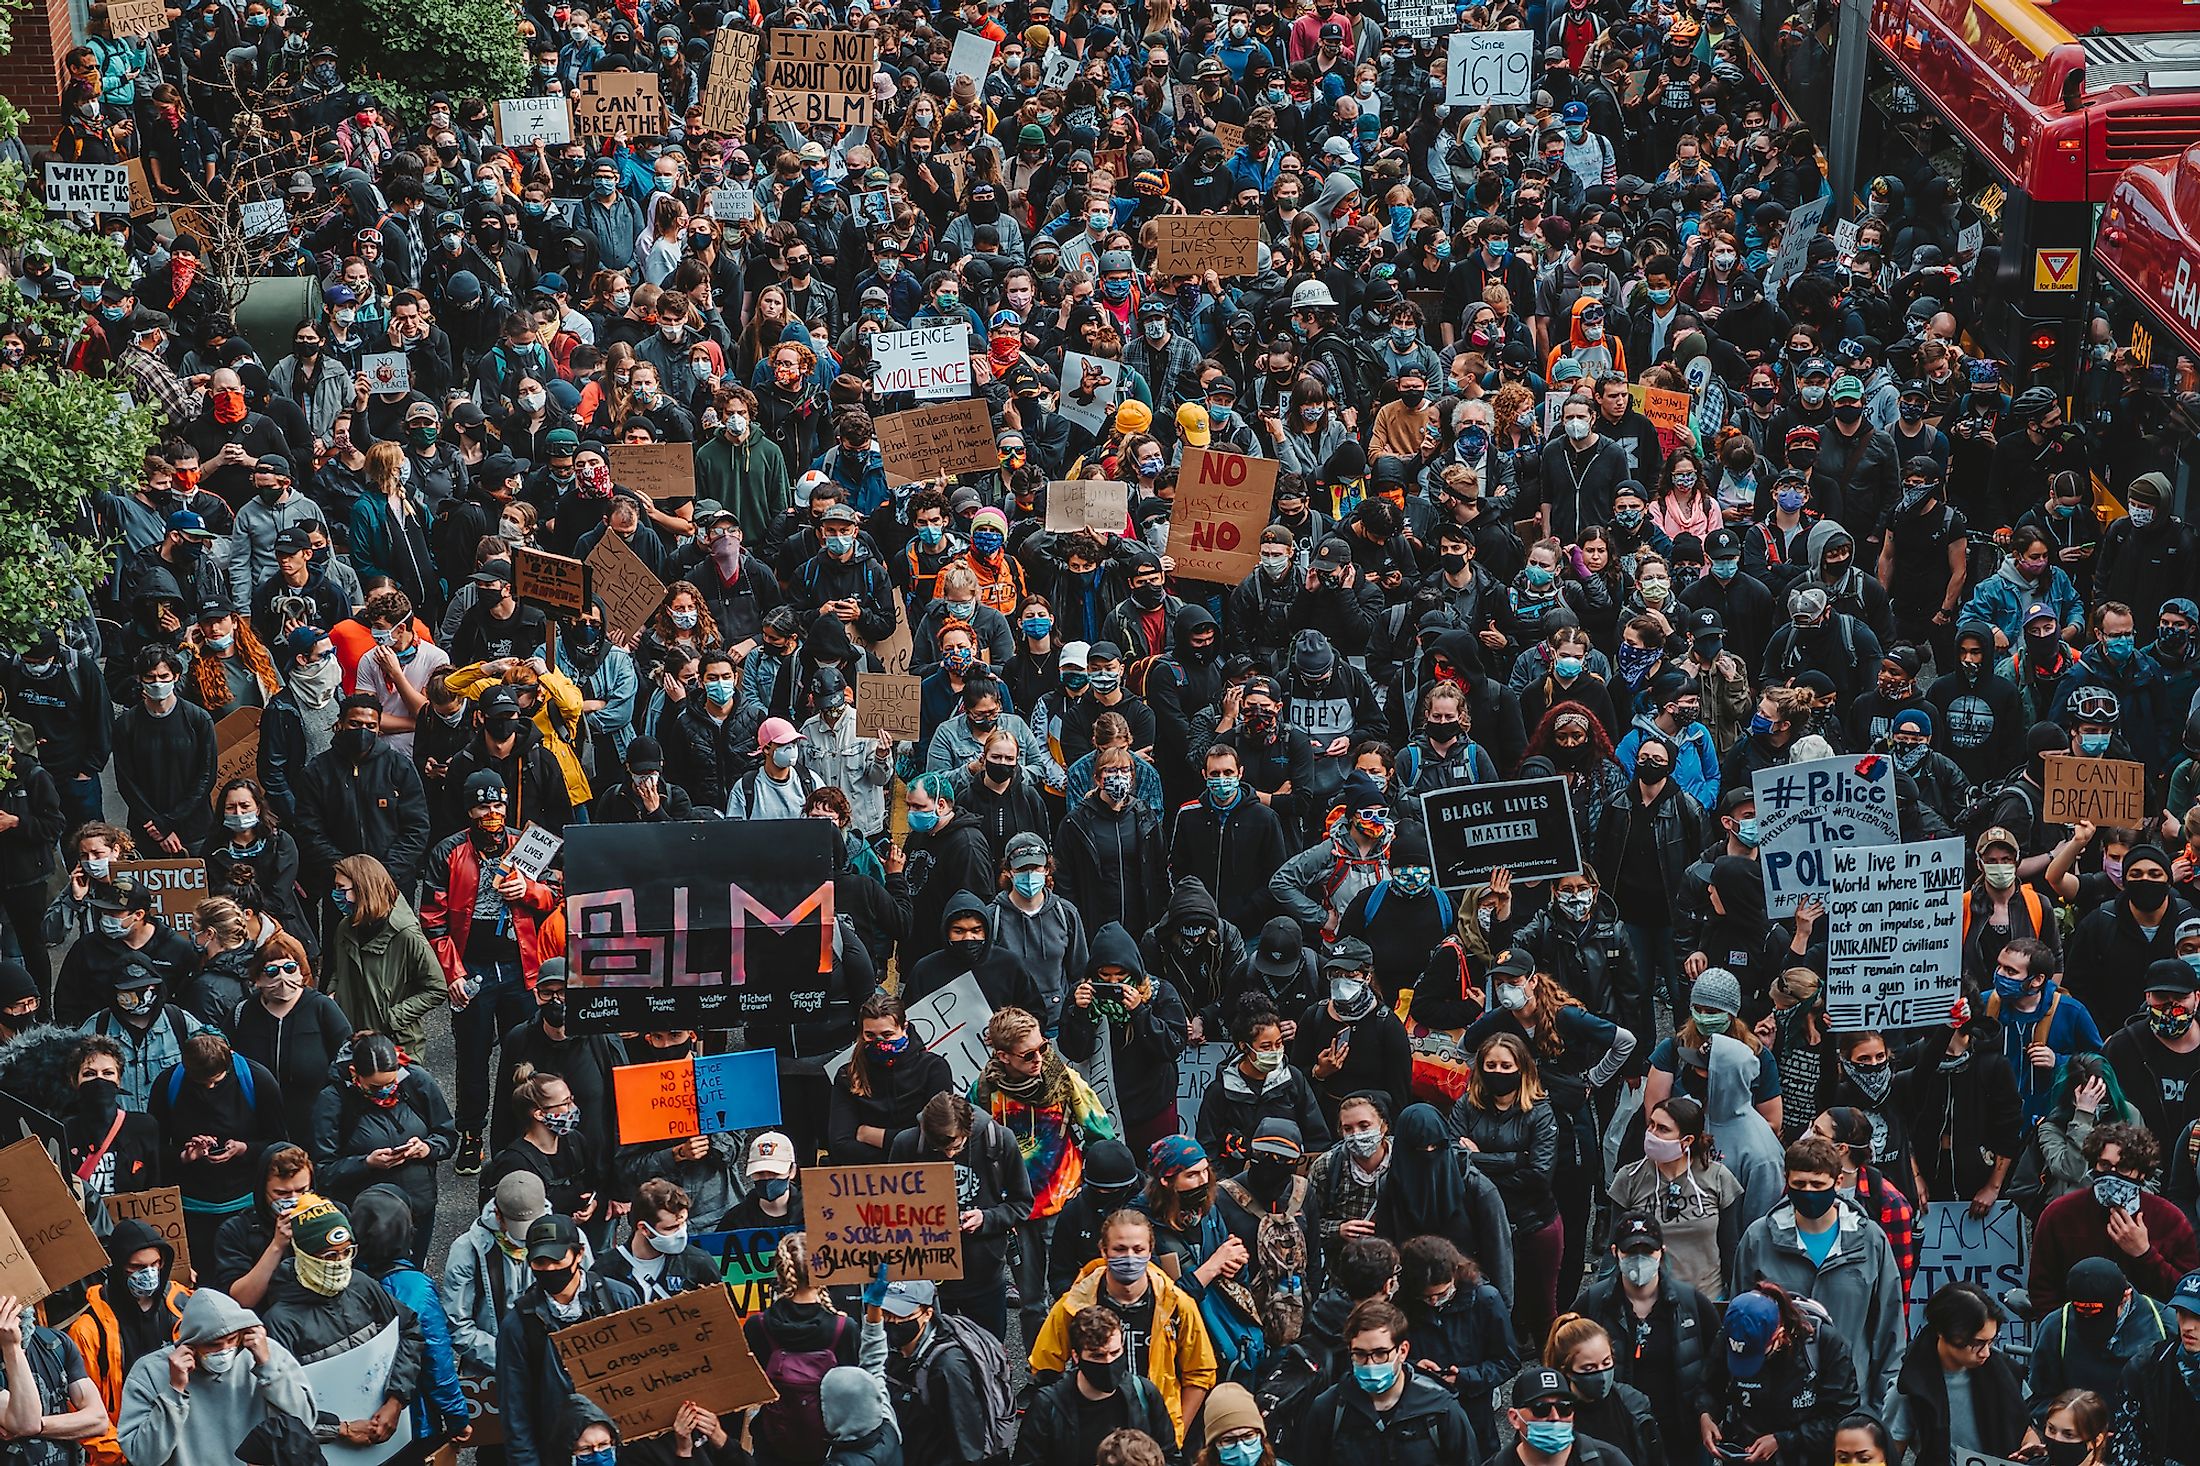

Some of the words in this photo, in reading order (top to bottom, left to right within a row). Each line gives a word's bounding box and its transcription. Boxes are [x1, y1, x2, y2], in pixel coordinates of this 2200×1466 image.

[114, 1, 159, 20] LIVES
[1389, 6, 1427, 18] oppressed
[1447, 5, 1455, 13] to
[111, 13, 167, 34] MATTER
[1401, 18, 1422, 28] react
[1426, 17, 1434, 25] to
[1438, 15, 1455, 24] their
[714, 29, 758, 62] BLACK
[832, 34, 872, 61] NOT
[1470, 36, 1505, 51] Since
[1985, 34, 2009, 62] HYBRID
[711, 53, 754, 83] LIVES
[771, 61, 830, 90] ABOUT
[833, 63, 871, 93] YOU
[1455, 53, 1530, 97] 1619
[583, 75, 598, 95] I
[719, 78, 736, 88] ARE
[1050, 78, 1065, 87] BLM
[508, 99, 560, 111] MIGHT
[596, 88, 654, 113] CAN'T
[705, 84, 749, 113] HUMAN
[583, 114, 659, 134] BREATHE
[702, 104, 745, 131] LIVES
[52, 166, 98, 182] WHY
[104, 169, 126, 184] DO
[47, 184, 60, 201] U
[69, 184, 109, 201] HATE
[114, 185, 129, 202] US
[717, 191, 748, 200] BLACK
[714, 211, 753, 219] MATTER
[720, 202, 746, 210] LIVES
[1169, 220, 1235, 238] BLACK
[1171, 238, 1217, 254] LIVES
[1168, 256, 1247, 271] MATTER
[2051, 282, 2073, 290] Buses
[876, 327, 956, 352] SILENCE
[2131, 320, 2153, 370] 6241
[875, 362, 968, 391] VIOLENCE
[928, 387, 954, 395] MATTER
[886, 416, 903, 433] I
[912, 408, 973, 428] understand
[882, 438, 908, 453] that
[913, 433, 928, 447] I
[931, 427, 949, 441] will
[953, 423, 985, 435] never
[888, 444, 954, 464] understand
[958, 437, 993, 451] however
[917, 457, 931, 475] I
[1198, 451, 1248, 488] NO
[1065, 507, 1115, 522] POLICE
[1189, 520, 1241, 553] NO
[859, 681, 920, 701] SILENCE
[876, 700, 896, 713] IS
[1291, 705, 1343, 728] OBEY
[858, 712, 919, 731] VIOLENCE
[2054, 762, 2062, 781] I
[2075, 763, 2140, 787] CAN'T
[1441, 801, 1494, 822] BLACK
[1503, 795, 1549, 813] LIVES
[2050, 788, 2142, 821] BREATHE
[530, 829, 555, 848] BLACK
[1471, 823, 1532, 843] MATTER
[1798, 815, 1855, 844] The
[523, 844, 545, 861] LIVES
[1834, 853, 1857, 873] We
[1868, 852, 1896, 873] live
[1905, 850, 1920, 868] in
[1931, 851, 1942, 863] a
[510, 854, 538, 875] MATTER
[1832, 875, 1870, 894] World
[1877, 873, 1917, 892] where
[1919, 866, 1964, 890] TRAINED
[1862, 901, 1883, 914] can
[1888, 897, 1919, 918] panic
[1925, 890, 1949, 908] and
[1831, 920, 1852, 933] act
[1858, 921, 1873, 933] on
[1934, 911, 1957, 927] but
[566, 880, 834, 988] BLM
[1830, 936, 1898, 956] UNTRAINED
[1902, 937, 1950, 953] civilians
[1829, 963, 1858, 976] must
[1863, 962, 1905, 976] remain
[1909, 959, 1939, 974] calm
[739, 993, 773, 1003] Michael
[789, 990, 826, 1001] George
[1829, 981, 1854, 996] with
[1862, 983, 1871, 994] a
[1874, 980, 1905, 1001] gun
[1914, 977, 1930, 992] in
[1934, 976, 1962, 990] their
[591, 997, 618, 1009] John
[793, 999, 822, 1011] Floyd
[1864, 998, 1914, 1027] FACE
[579, 1008, 620, 1020] Crawford
[660, 1070, 674, 1080] NO
[661, 1082, 676, 1092] NO
[828, 1170, 927, 1198] SILENCE
[118, 1193, 177, 1220] LIVES
[821, 1206, 835, 1219] is
[856, 1203, 947, 1228] VIOLENCE
[825, 1231, 838, 1242] so
[842, 1226, 913, 1246] SCREAM
[919, 1227, 952, 1245] that
[665, 1275, 684, 1291] W
[658, 1304, 701, 1326] The
[580, 1342, 681, 1379] Language
[594, 1382, 636, 1405] The
[641, 1355, 713, 1393] Unheard
[1741, 1391, 1752, 1407] 2
